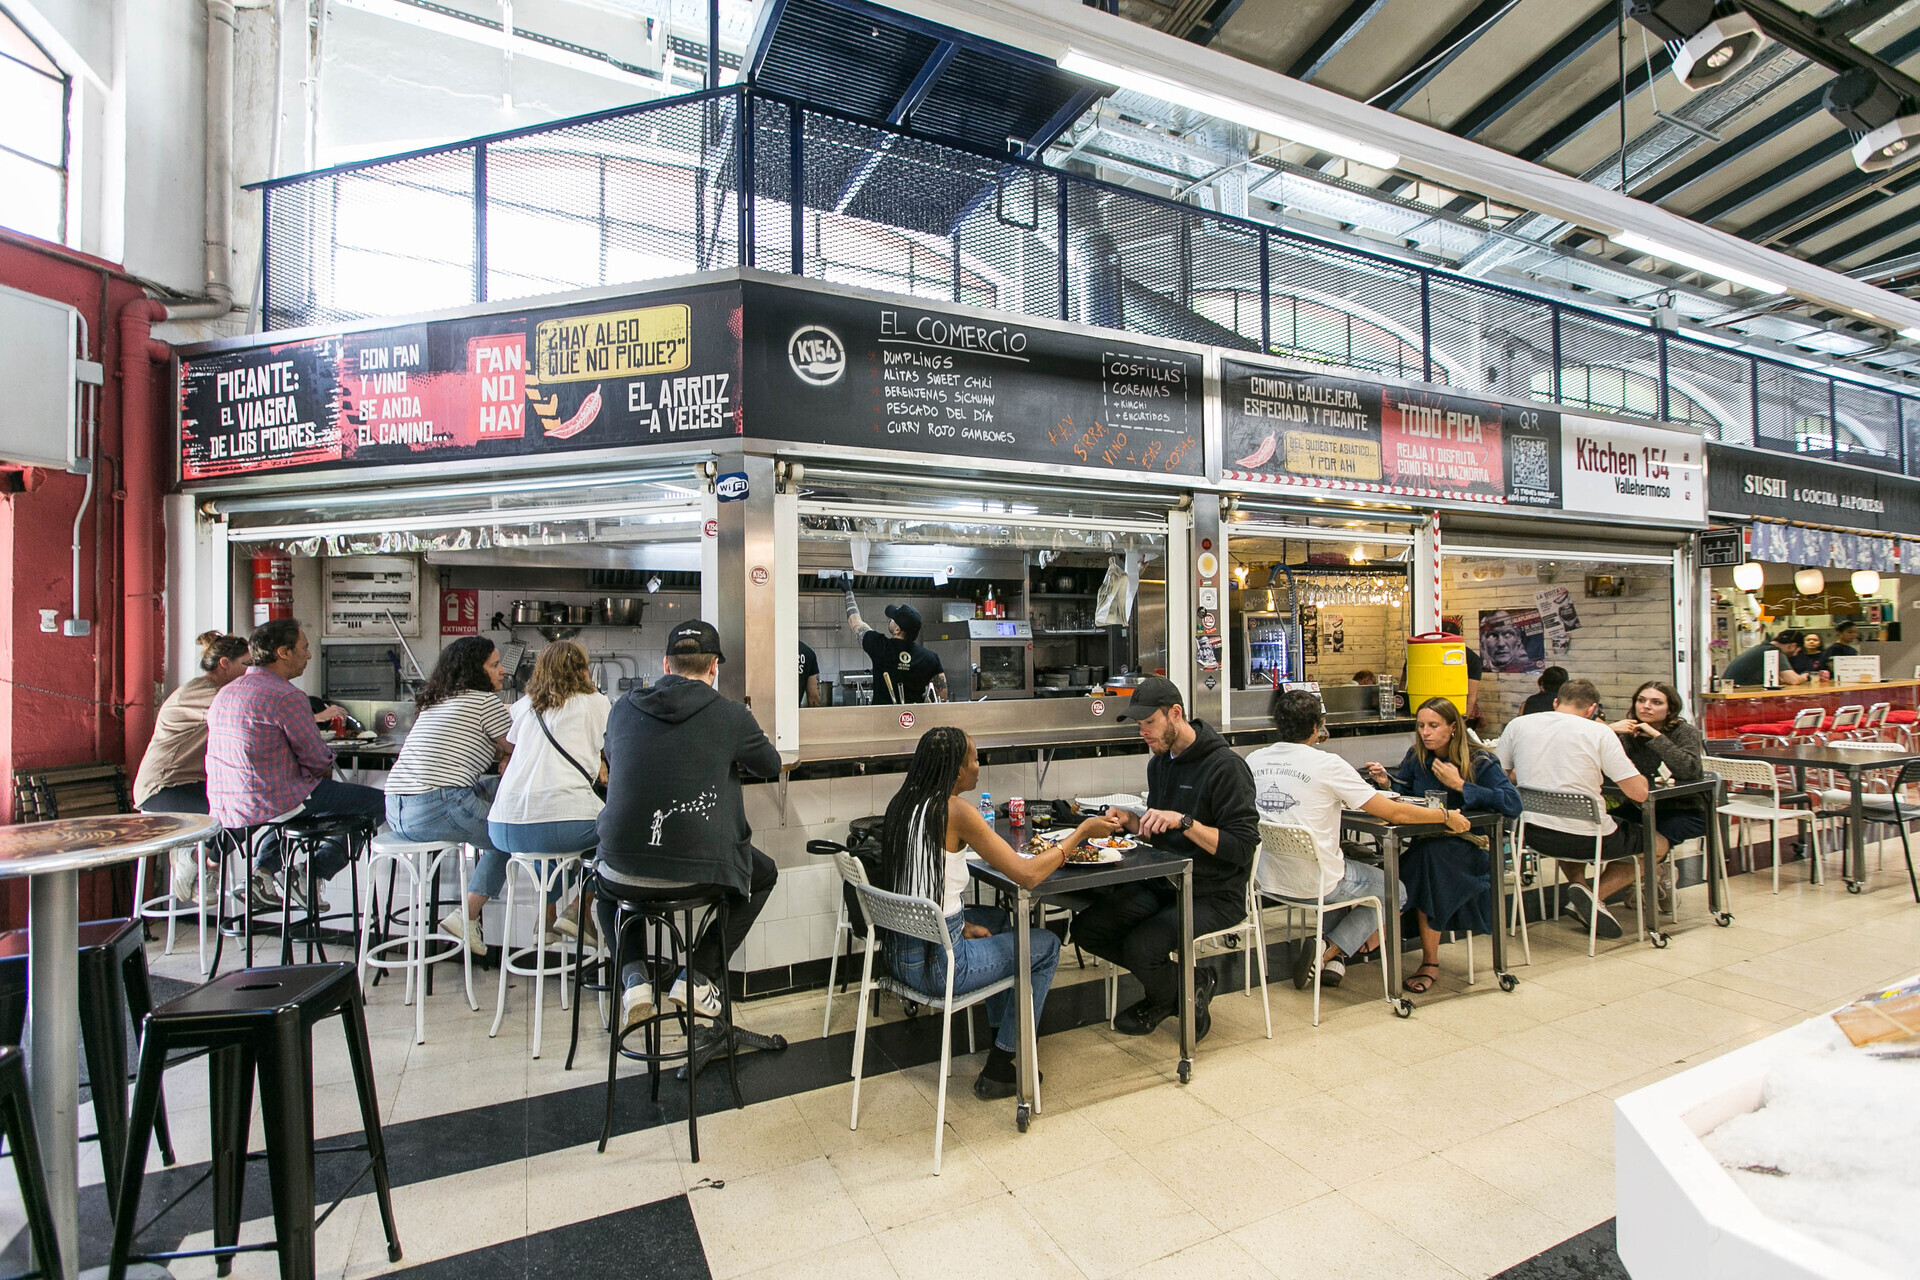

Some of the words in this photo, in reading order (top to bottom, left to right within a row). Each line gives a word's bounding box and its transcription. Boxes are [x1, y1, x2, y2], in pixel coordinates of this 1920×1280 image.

[596, 318, 639, 346] ALGO
[881, 310, 906, 335] EL
[360, 348, 388, 370] CON
[393, 344, 419, 367] PAN
[476, 344, 522, 374] PAN
[548, 352, 578, 376] QUE
[586, 348, 609, 372] NO
[797, 340, 837, 362] K154
[217, 361, 299, 402] PICANTE:
[360, 375, 370, 395] Y
[373, 371, 407, 393] VINO
[482, 374, 515, 402] NO
[926, 372, 960, 388] SWEET
[1113, 383, 1171, 398] COREANAS
[1251, 376, 1294, 400] COMIDA
[628, 382, 652, 412] EL
[659, 374, 730, 408] ARROZ
[884, 386, 947, 403] BERENJENAS
[220, 407, 234, 426] EL
[237, 396, 298, 430] VIAGRA
[359, 400, 377, 421] SE
[382, 397, 421, 419] ANDA
[480, 404, 524, 432] HAY
[886, 402, 938, 418] PESCADO
[946, 407, 966, 420] DEL
[1244, 398, 1309, 423] ESPECIADA
[1312, 409, 1320, 424] Y
[1323, 410, 1368, 432] PICANTE
[1520, 411, 1540, 431] QR
[358, 425, 374, 446] EL
[378, 421, 447, 445] CAMINO...
[887, 421, 920, 434] CURRY
[928, 424, 955, 438] ROJO
[962, 427, 1016, 444] GAMBONES
[1398, 403, 1441, 439] TODO
[1447, 411, 1482, 444] PICA
[210, 436, 227, 459] DE
[230, 432, 257, 457] LOS
[1048, 415, 1076, 446] HAY
[1126, 451, 1137, 465] Y
[1142, 440, 1161, 470] ESAS
[1164, 435, 1196, 471] COSAS
[1290, 437, 1303, 449] DEL
[1305, 440, 1337, 453] SUDESTE
[1397, 443, 1428, 460] RELAJA
[1430, 447, 1435, 461] Y
[1437, 448, 1478, 466] DISFRUTA.
[1309, 455, 1314, 468] Y
[1318, 457, 1337, 471] POR
[1340, 459, 1355, 472] AHÍ
[1398, 459, 1421, 475] COMO
[1422, 462, 1434, 476] EN
[1436, 464, 1447, 478] LA
[1448, 465, 1490, 482] MAZMORRA
[1576, 437, 1637, 476] Kitchen
[1643, 447, 1669, 480] 154
[1615, 477, 1670, 498] Vallehermoso
[1744, 474, 1787, 498] SUSHI
[1802, 489, 1838, 507] COCINA
[1840, 495, 1884, 513] JAPONESA
[1276, 768, 1311, 783] THOUSAND
